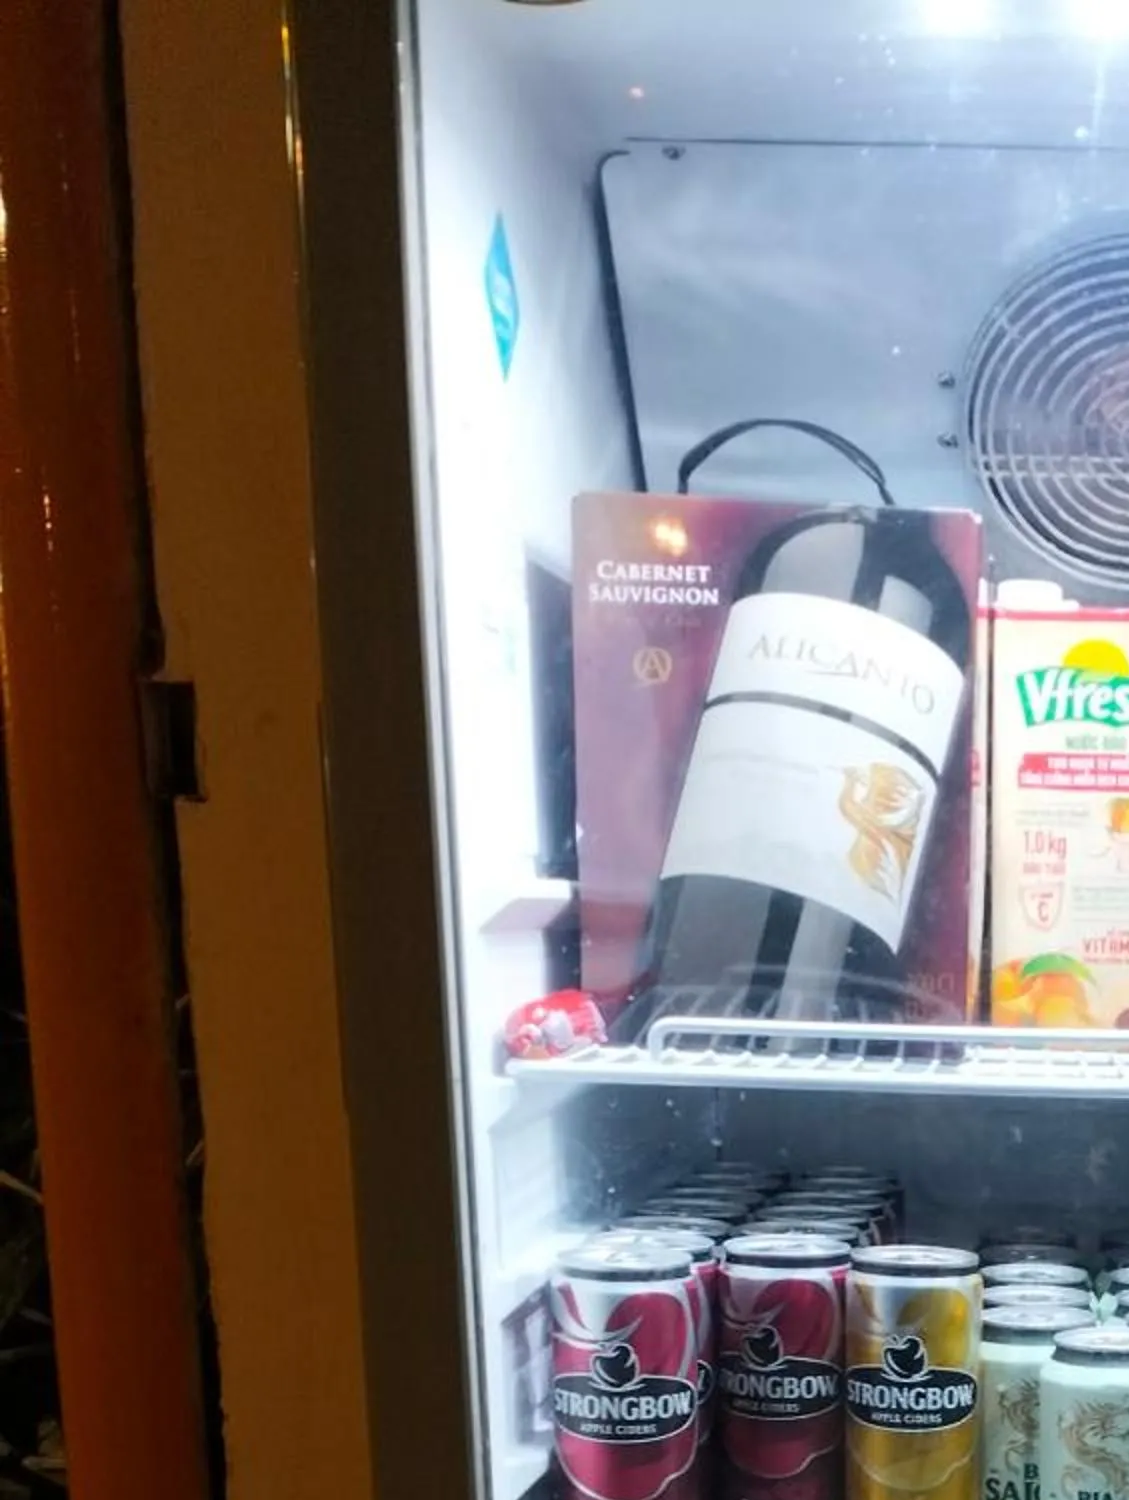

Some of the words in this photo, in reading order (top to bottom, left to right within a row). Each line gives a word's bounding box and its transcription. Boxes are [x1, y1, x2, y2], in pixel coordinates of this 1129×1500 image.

[597, 560, 711, 583] CABERNET
[589, 583, 720, 605] SAUVIGNON
[749, 634, 936, 716] ALICANTO
[721, 1367, 839, 1400] RONGBOW
[848, 1379, 974, 1411] STRONGBOW
[554, 1387, 692, 1421] STRONGBOW
